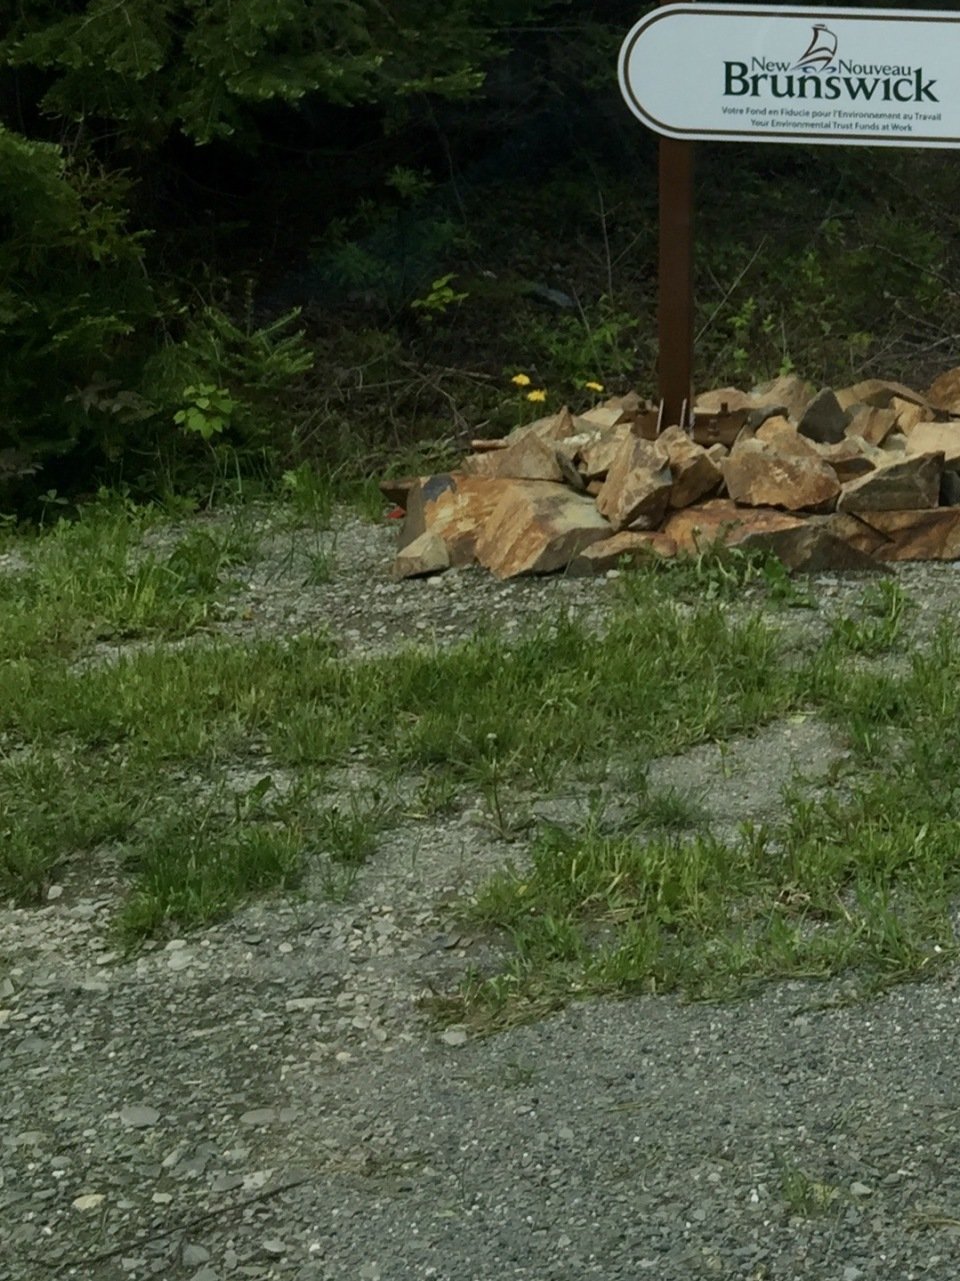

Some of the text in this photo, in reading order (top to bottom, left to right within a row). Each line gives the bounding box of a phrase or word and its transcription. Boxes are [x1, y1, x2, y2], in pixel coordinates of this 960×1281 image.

[751, 56, 791, 72] New
[838, 59, 911, 76] Nouveau
[723, 61, 940, 103] Brunswick
[721, 106, 744, 115] Votre
[781, 108, 810, 118] Fiducie
[812, 111, 831, 120] pour
[915, 112, 942, 121] Travail
[750, 119, 770, 128] Your
[771, 119, 831, 130] Environmental
[833, 121, 853, 130] Trust
[855, 122, 880, 131] Funds
[891, 123, 912, 132] Work
